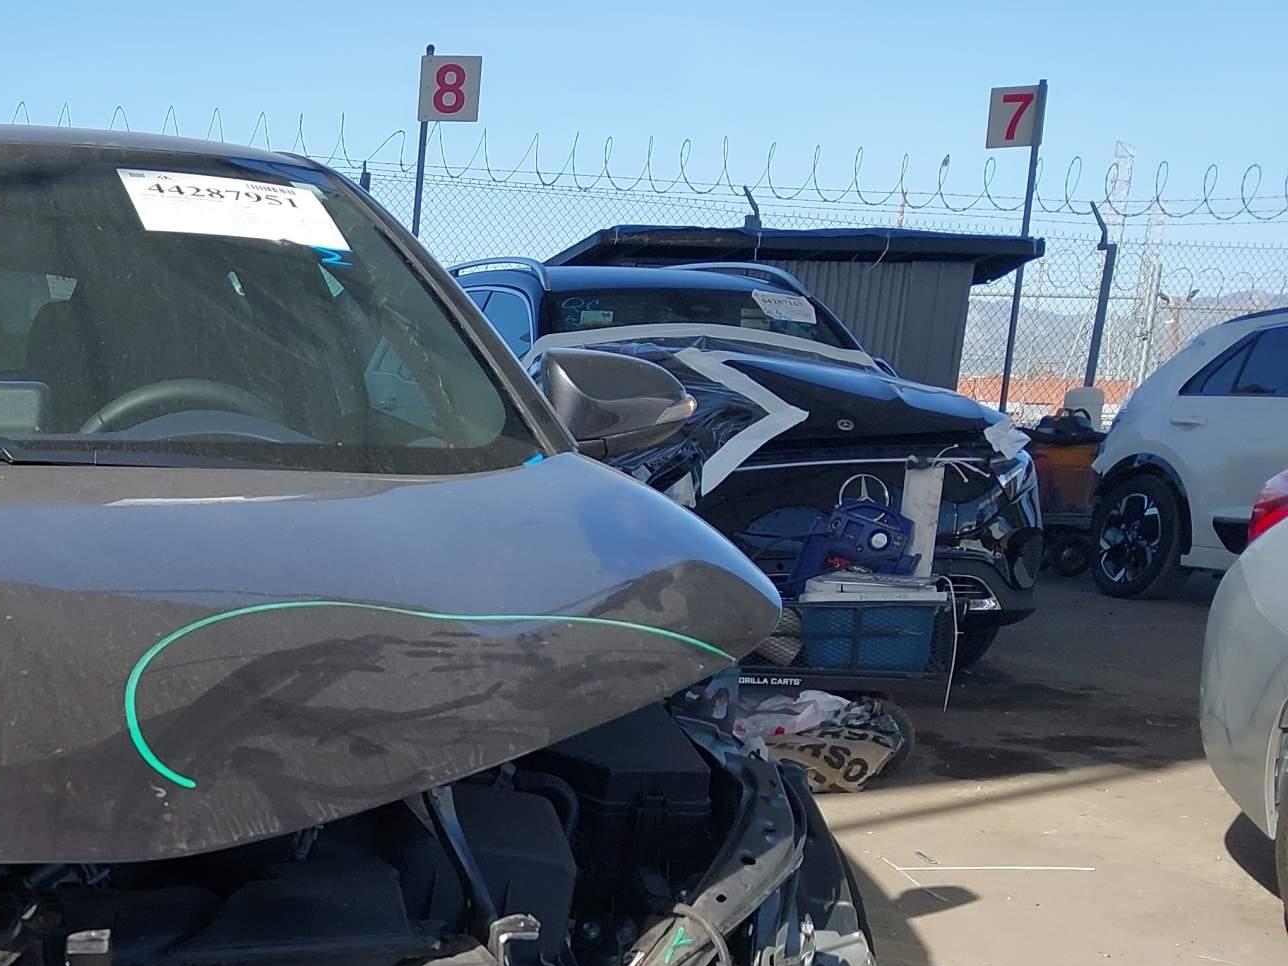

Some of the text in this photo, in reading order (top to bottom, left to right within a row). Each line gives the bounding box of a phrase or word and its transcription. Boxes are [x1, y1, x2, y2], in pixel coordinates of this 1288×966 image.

[433, 63, 466, 113] 8
[1003, 93, 1034, 140] 7
[148, 183, 299, 208] 44287951
[738, 676, 769, 685] ORILLA
